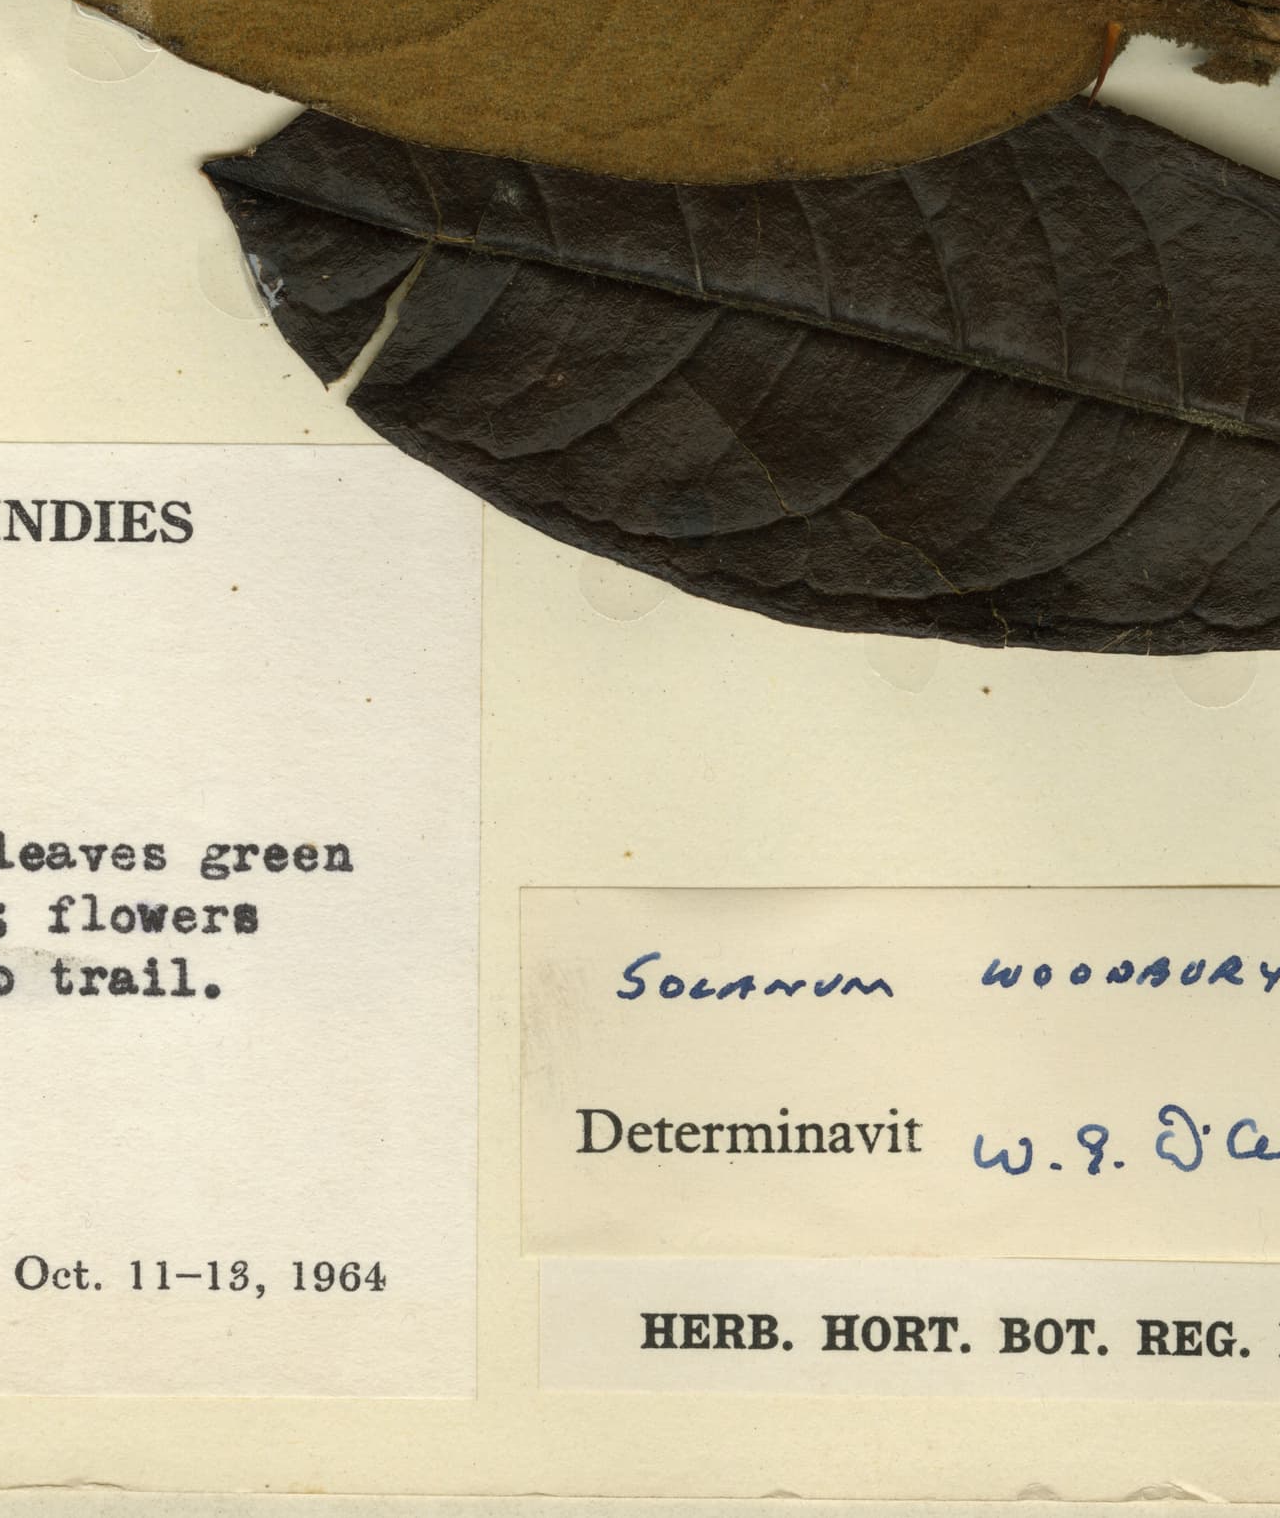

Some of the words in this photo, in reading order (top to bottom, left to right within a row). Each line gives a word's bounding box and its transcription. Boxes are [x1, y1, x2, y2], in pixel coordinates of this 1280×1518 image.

[199, 842, 355, 881] green
[47, 892, 259, 935] flowers
[49, 956, 222, 1000] trail.
[615, 951, 894, 1001] SOLANUM
[575, 1107, 924, 1155] Determinavit
[14, 1254, 102, 1291] Oct.
[292, 1260, 387, 1293] 1964
[639, 1312, 794, 1352] HERB.
[820, 1313, 972, 1354] HORT.
[998, 1316, 1109, 1357] BOT.
[1135, 1318, 1251, 1359] REG.
